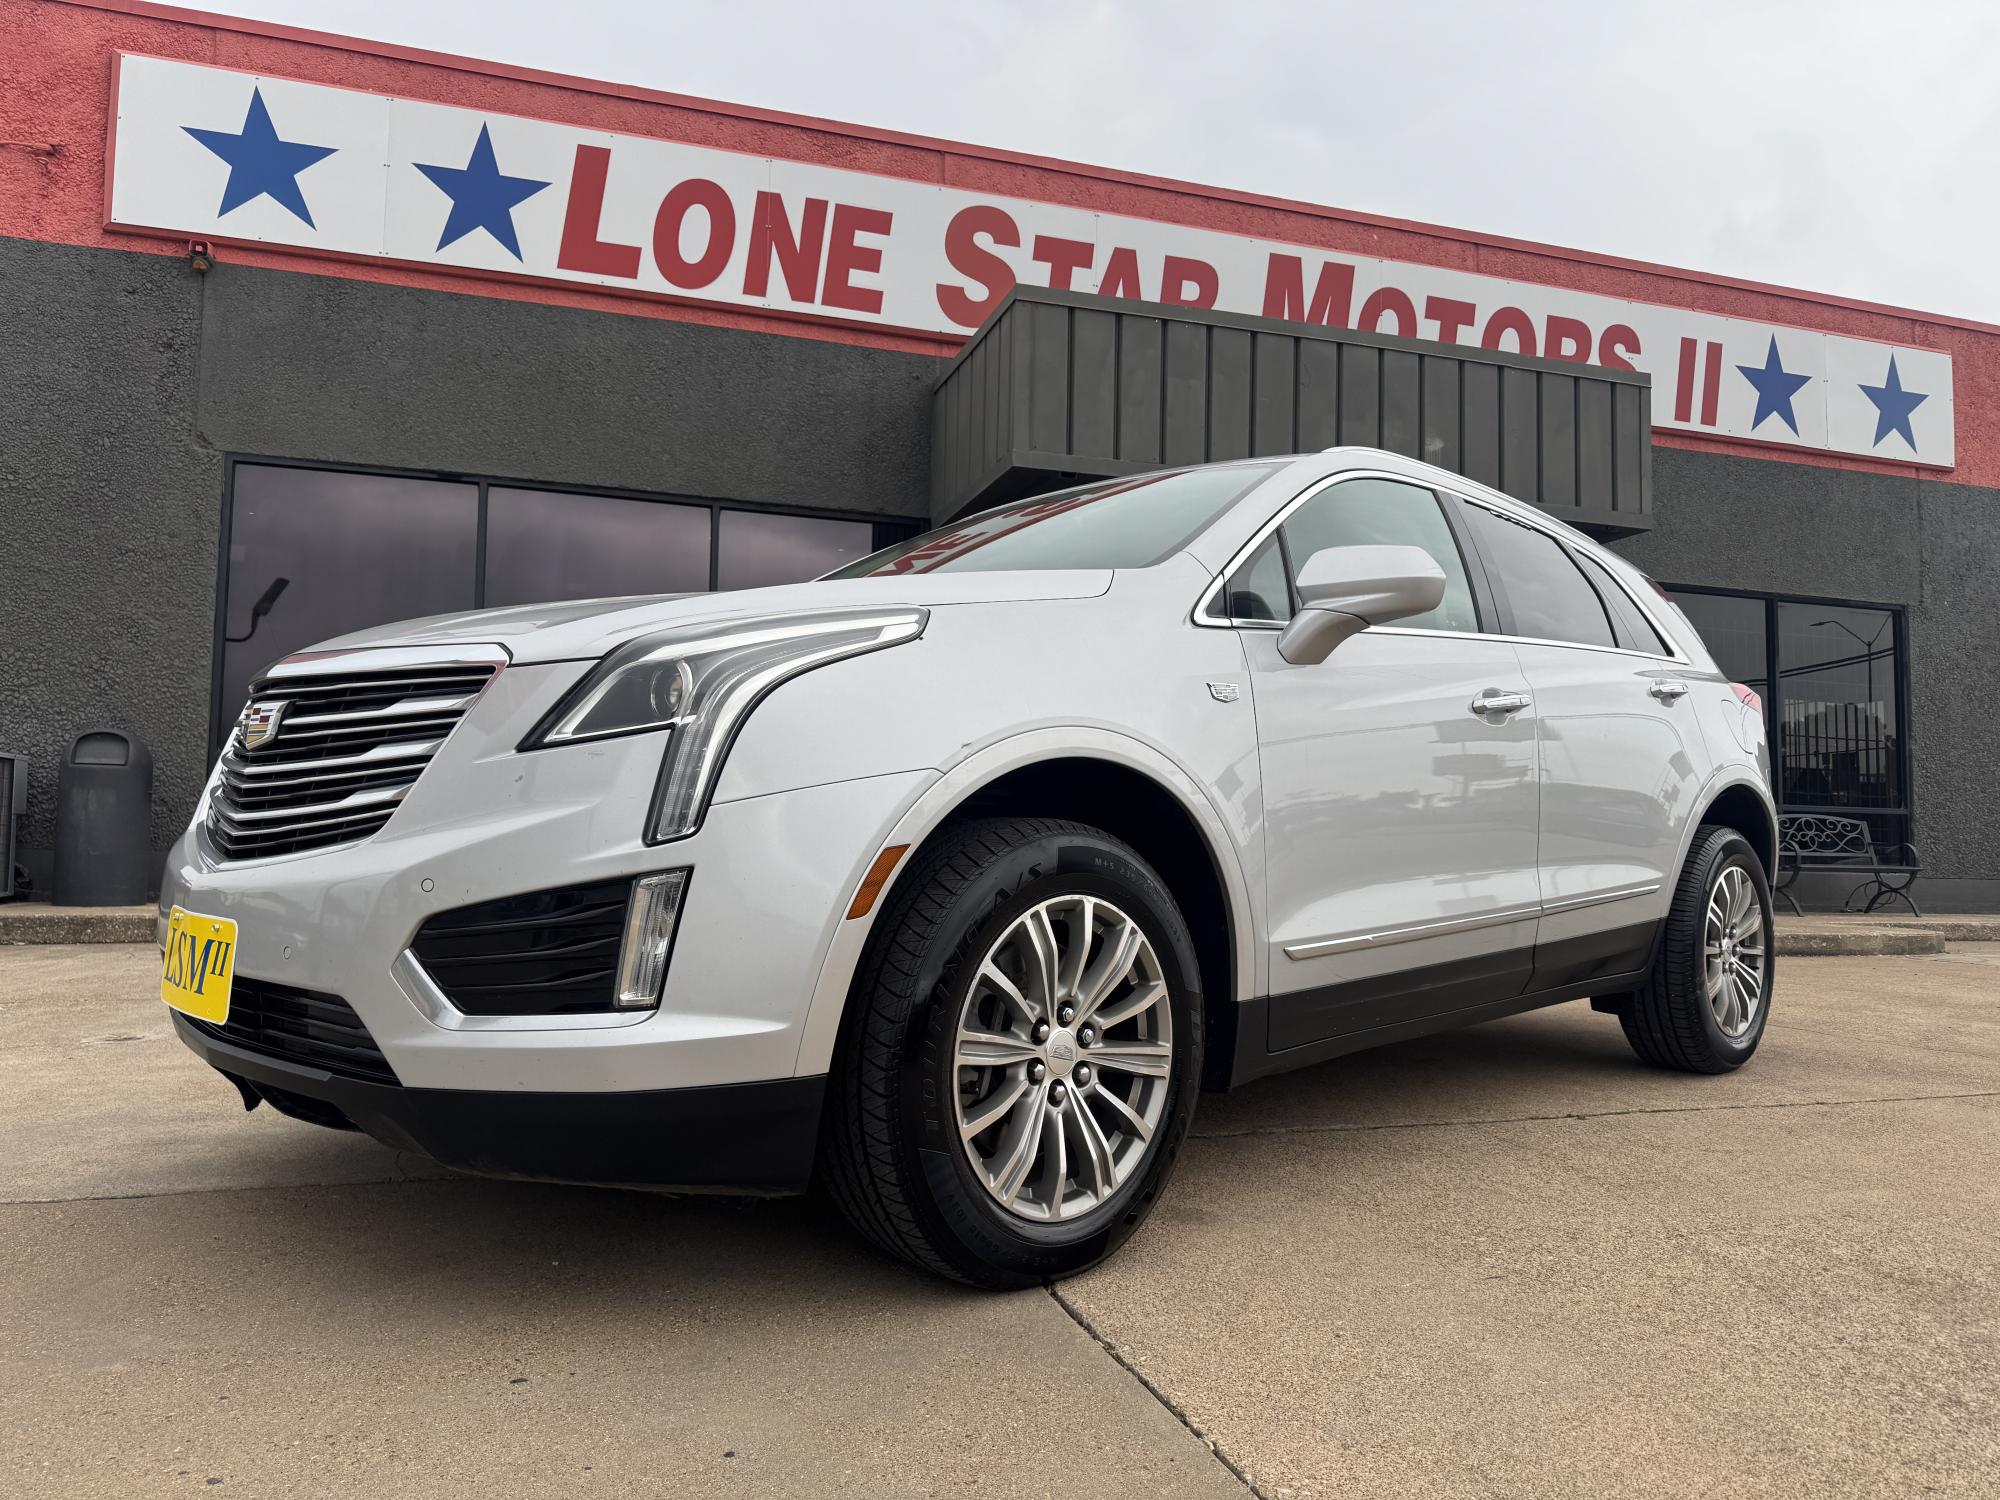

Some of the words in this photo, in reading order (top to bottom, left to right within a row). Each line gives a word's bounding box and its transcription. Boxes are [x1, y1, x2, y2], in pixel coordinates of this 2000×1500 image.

[557, 144, 893, 314] LONE
[936, 205, 1219, 328] STAR
[1674, 337, 1722, 426] II
